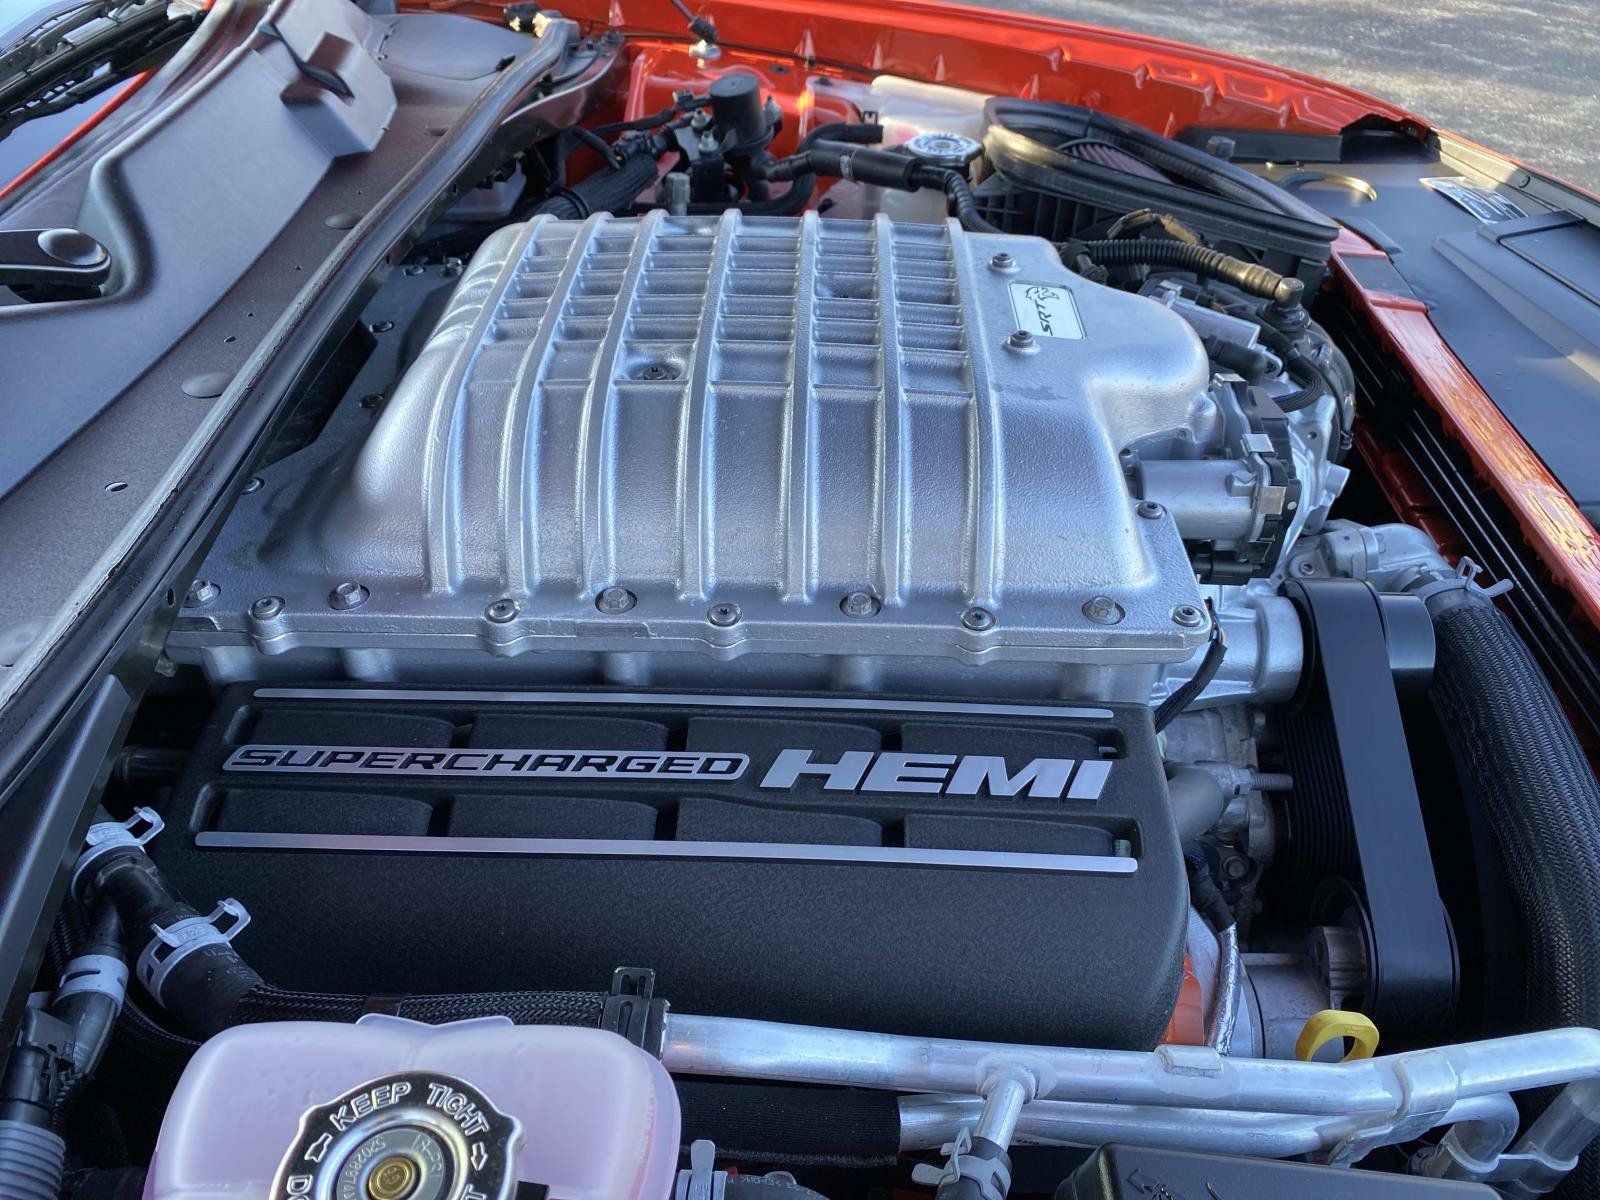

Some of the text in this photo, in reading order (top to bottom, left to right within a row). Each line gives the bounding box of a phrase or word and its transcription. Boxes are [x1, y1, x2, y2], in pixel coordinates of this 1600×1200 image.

[1034, 300, 1053, 336] SRT
[230, 747, 1113, 800] SUPERCHARGED HEMI
[329, 1081, 490, 1137] KEEP TIGHT
